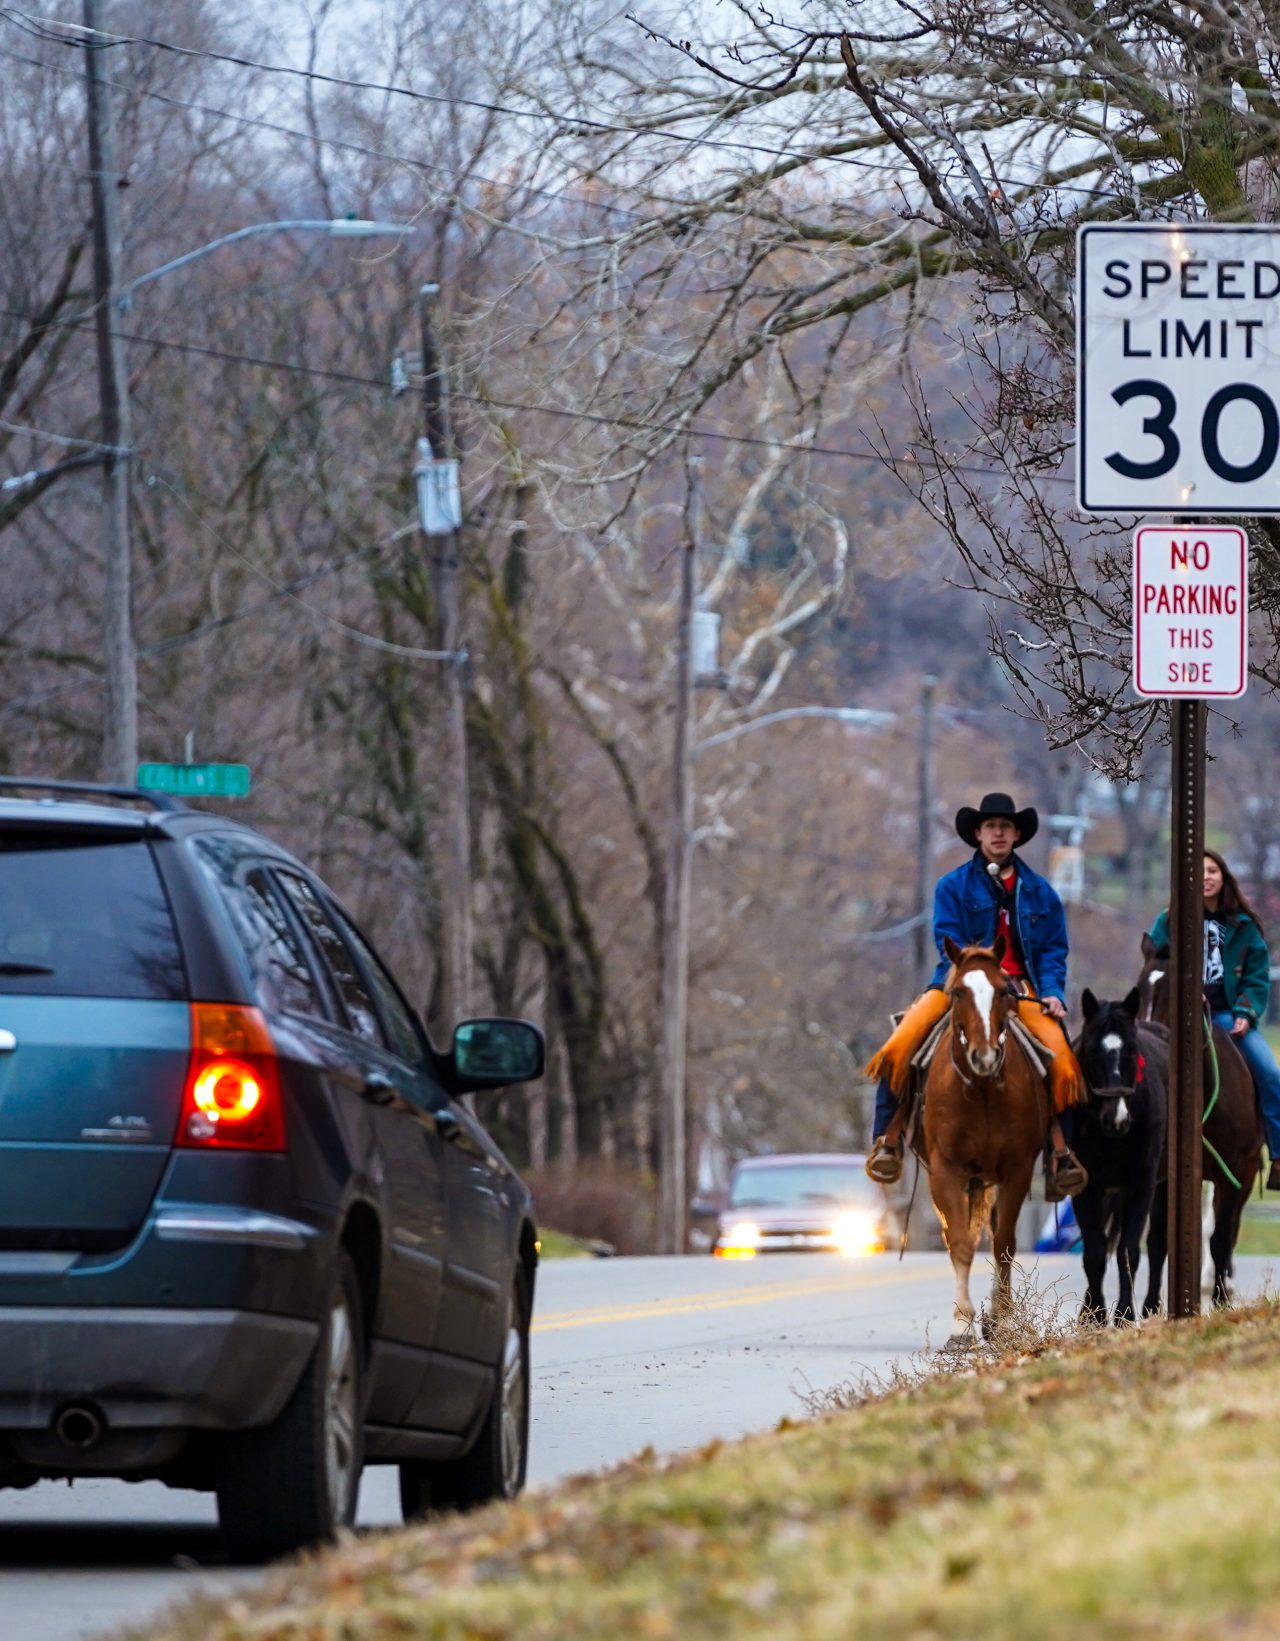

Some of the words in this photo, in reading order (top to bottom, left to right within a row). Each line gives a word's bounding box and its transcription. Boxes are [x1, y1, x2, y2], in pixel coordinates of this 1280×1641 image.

[1122, 319, 1264, 358] LIMIT
[1103, 379, 1280, 483] 30
[1171, 540, 1210, 571] NO
[1143, 585, 1238, 615] PARKING
[1168, 628, 1213, 649] THIS
[1168, 661, 1213, 683] SIDE
